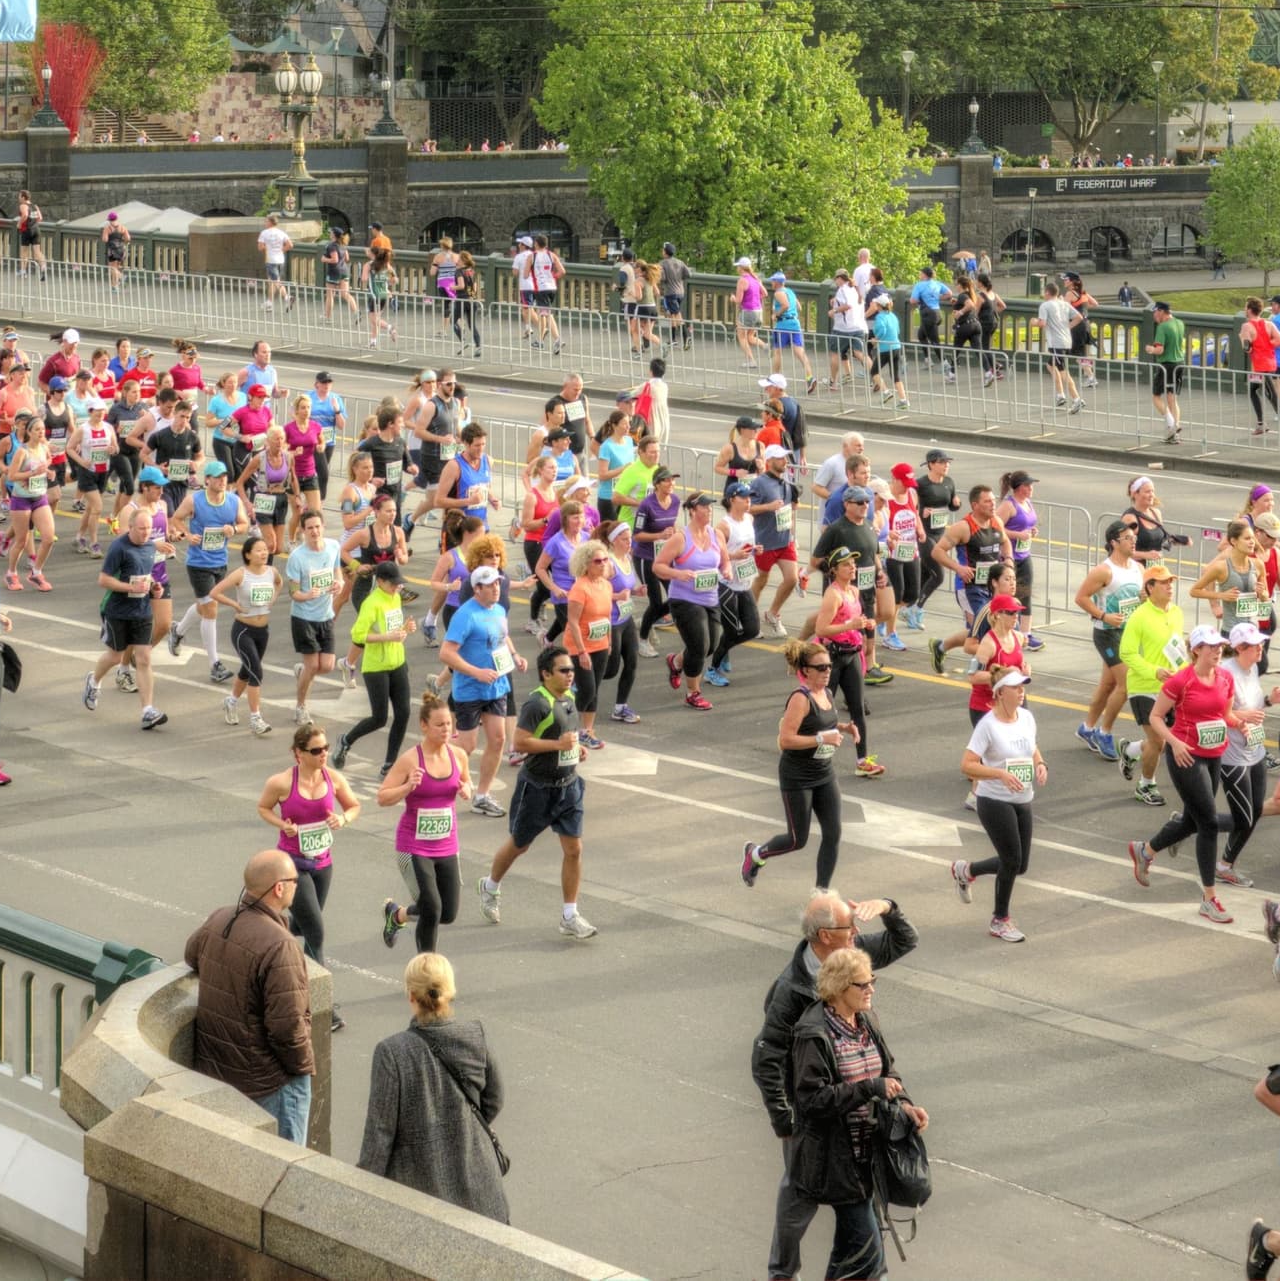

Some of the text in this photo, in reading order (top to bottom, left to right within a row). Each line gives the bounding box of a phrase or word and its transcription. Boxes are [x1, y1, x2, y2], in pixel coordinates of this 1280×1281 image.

[1073, 178, 1157, 189] FEDERATION WHARF
[1202, 729, 1224, 744] 20017
[420, 820, 449, 833] 22369
